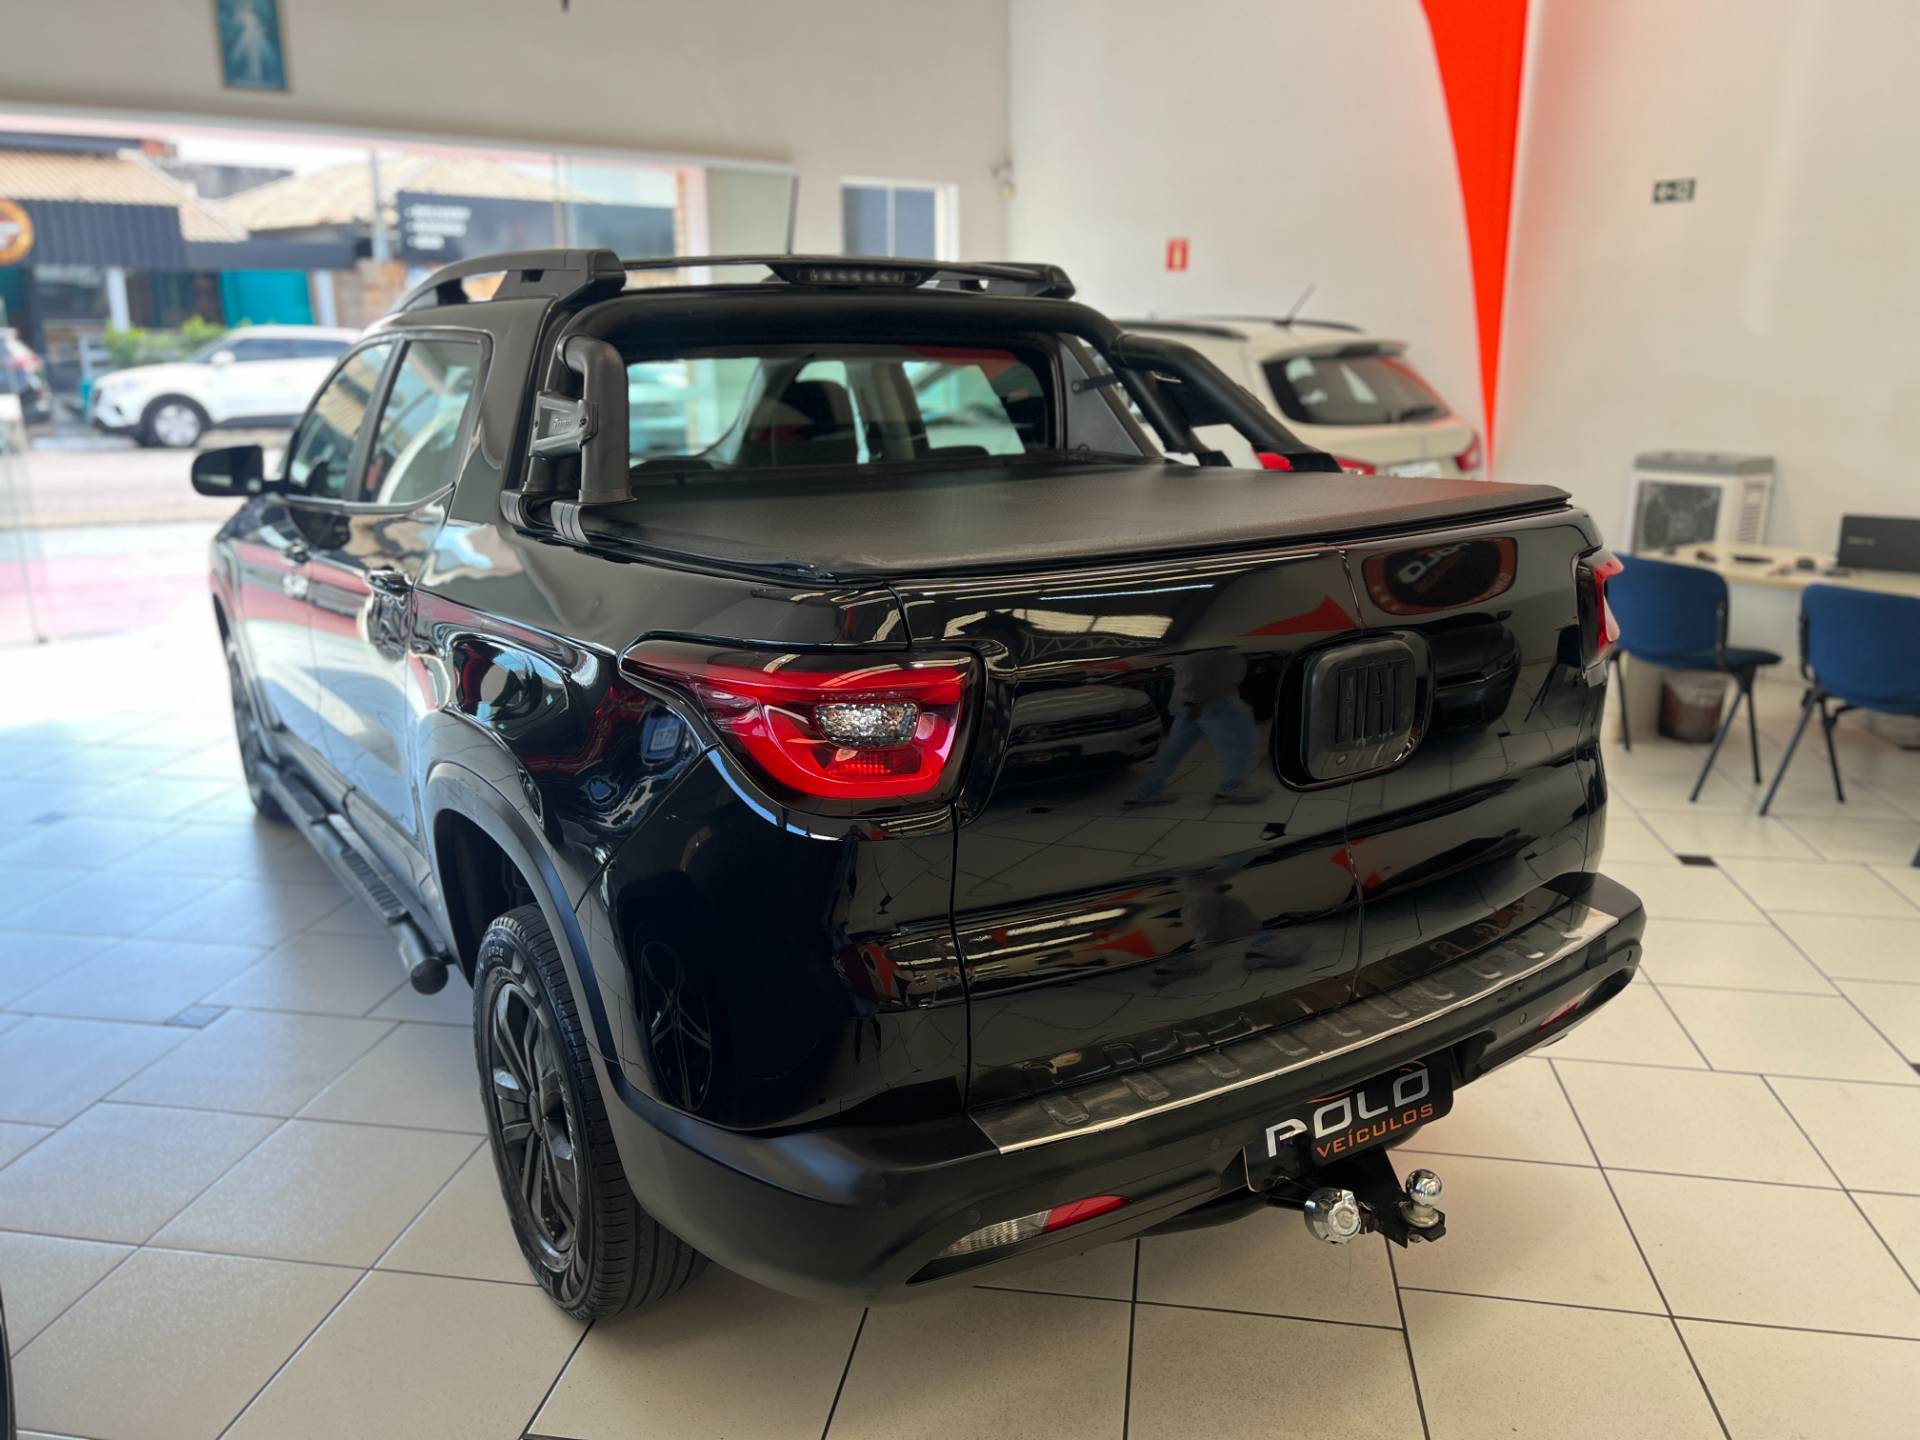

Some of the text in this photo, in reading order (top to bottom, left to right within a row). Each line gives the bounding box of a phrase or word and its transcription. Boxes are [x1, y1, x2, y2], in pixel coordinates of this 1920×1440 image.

[1333, 655, 1408, 744] FIAT
[1264, 1068, 1430, 1158] POLO
[1315, 1103, 1434, 1158] VEÍCULOS
